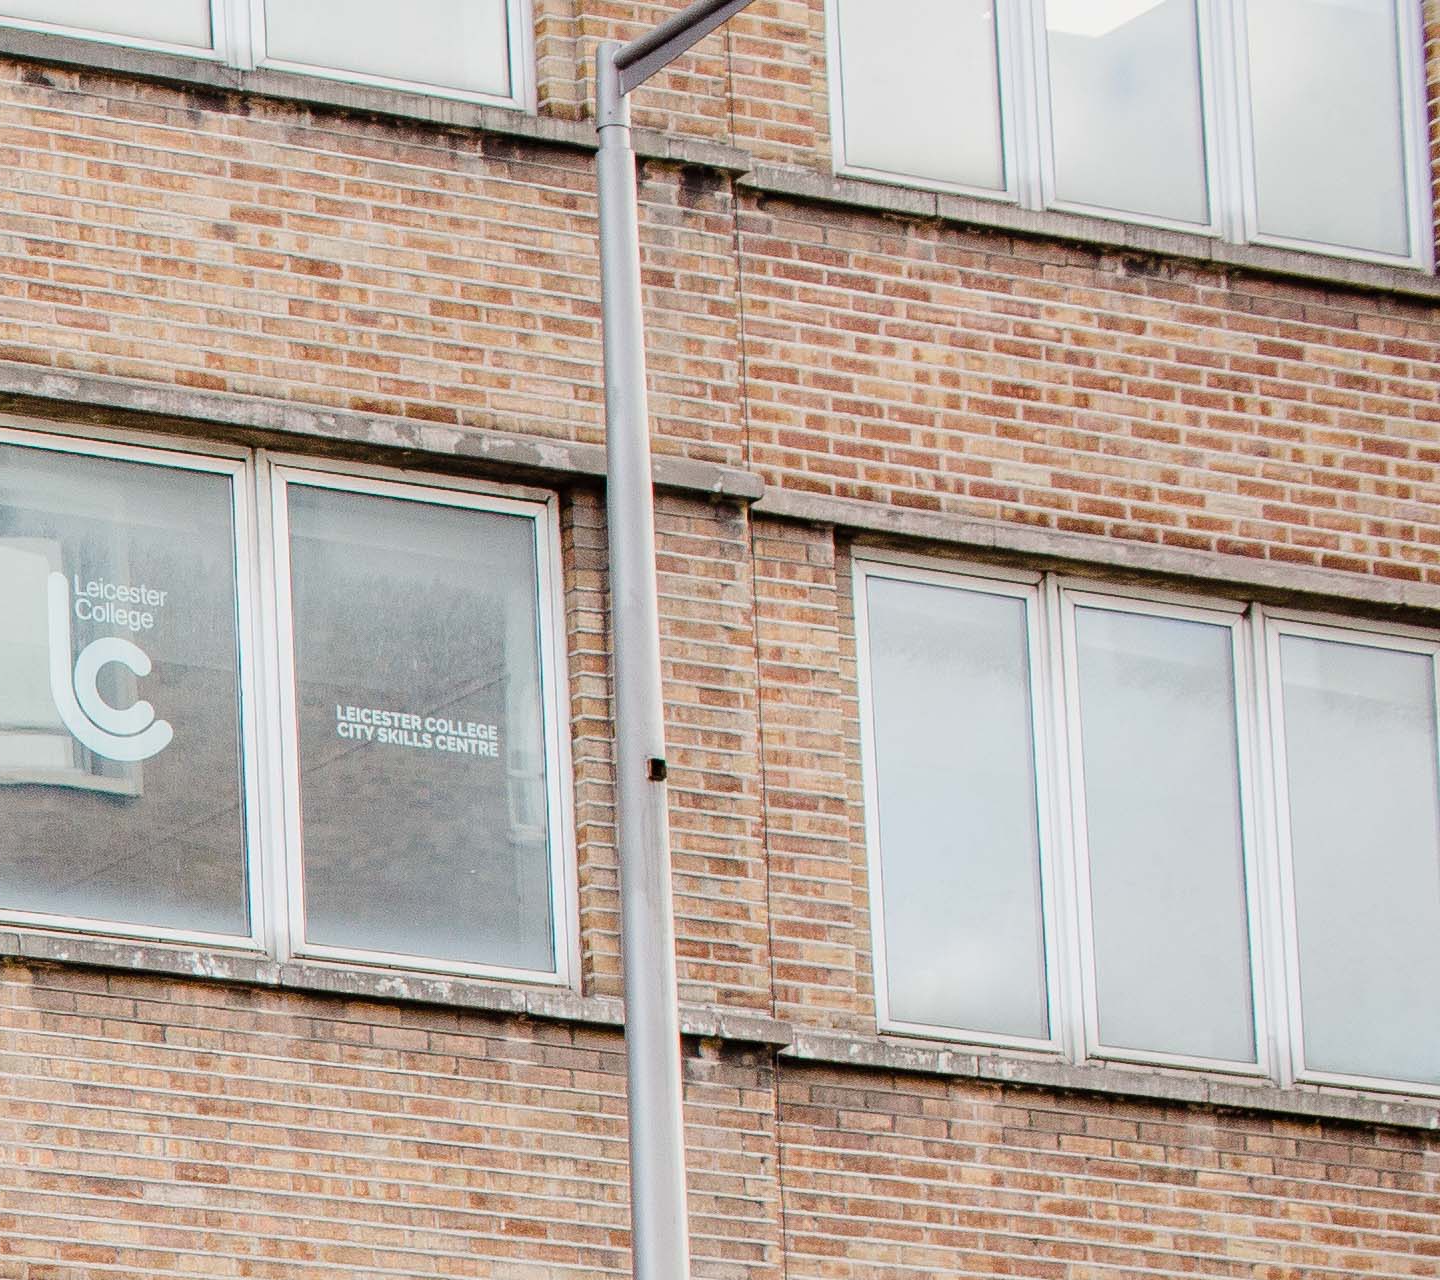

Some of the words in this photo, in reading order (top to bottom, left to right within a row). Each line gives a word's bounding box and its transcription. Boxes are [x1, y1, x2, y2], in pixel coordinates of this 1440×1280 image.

[74, 574, 168, 607] Leicester
[75, 599, 154, 631] College
[336, 704, 422, 731] LEICESTER
[424, 717, 498, 741] COLLEGE
[336, 722, 374, 740] CITY
[377, 728, 432, 748] SKILLS
[435, 735, 500, 757] CENTRE
